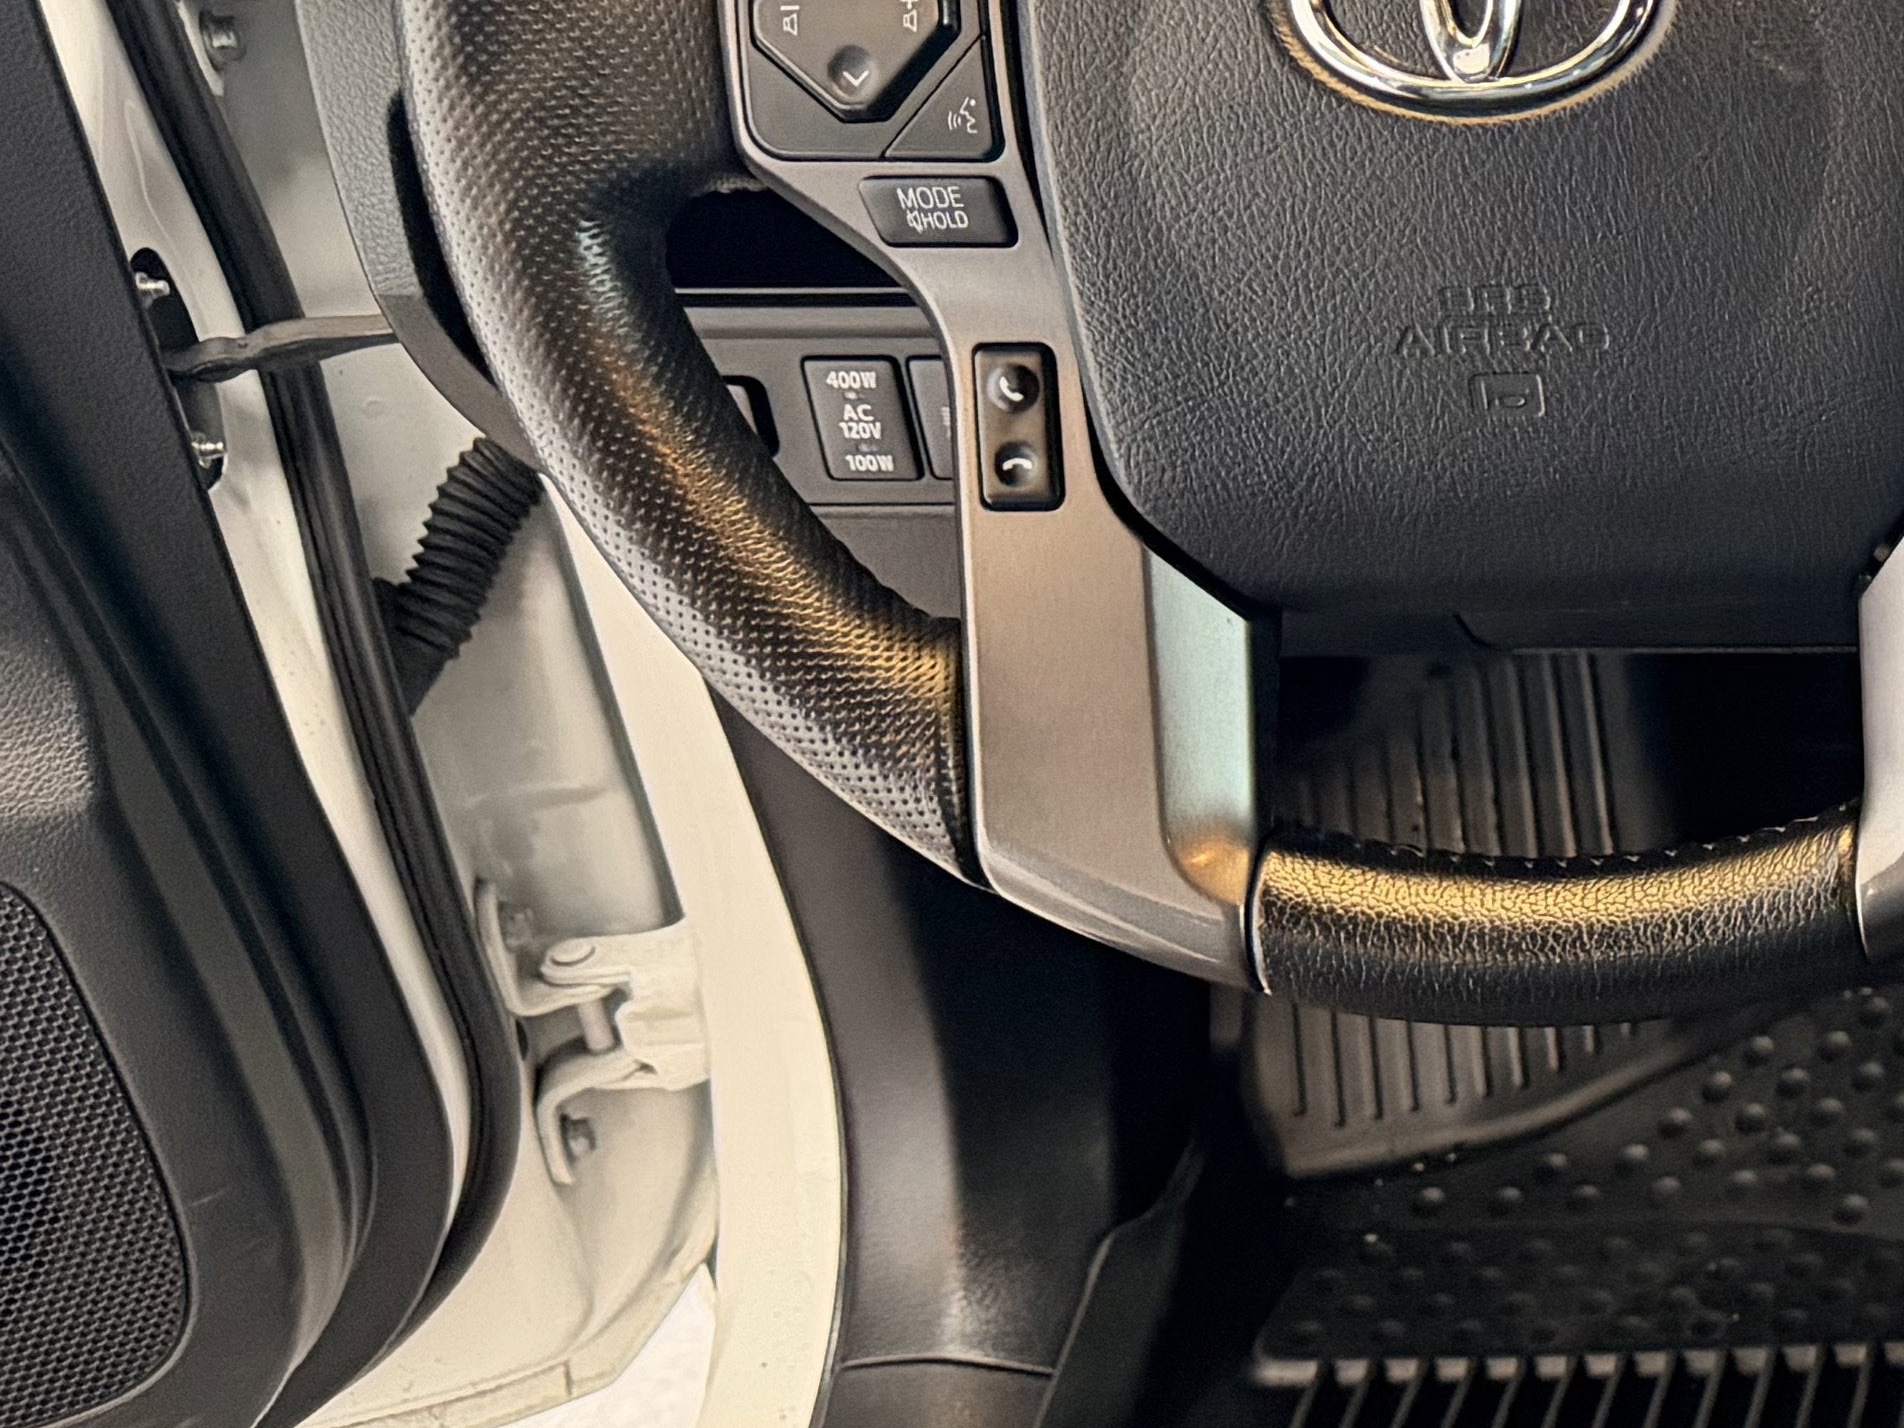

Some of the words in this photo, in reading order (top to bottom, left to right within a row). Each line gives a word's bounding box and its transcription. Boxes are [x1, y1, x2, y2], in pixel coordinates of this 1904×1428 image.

[896, 185, 965, 210] MODE
[920, 210, 969, 229] HOLD
[825, 370, 877, 389] 400W
[842, 403, 875, 422] AC
[838, 421, 882, 440] 120V
[844, 454, 895, 472] 100W
